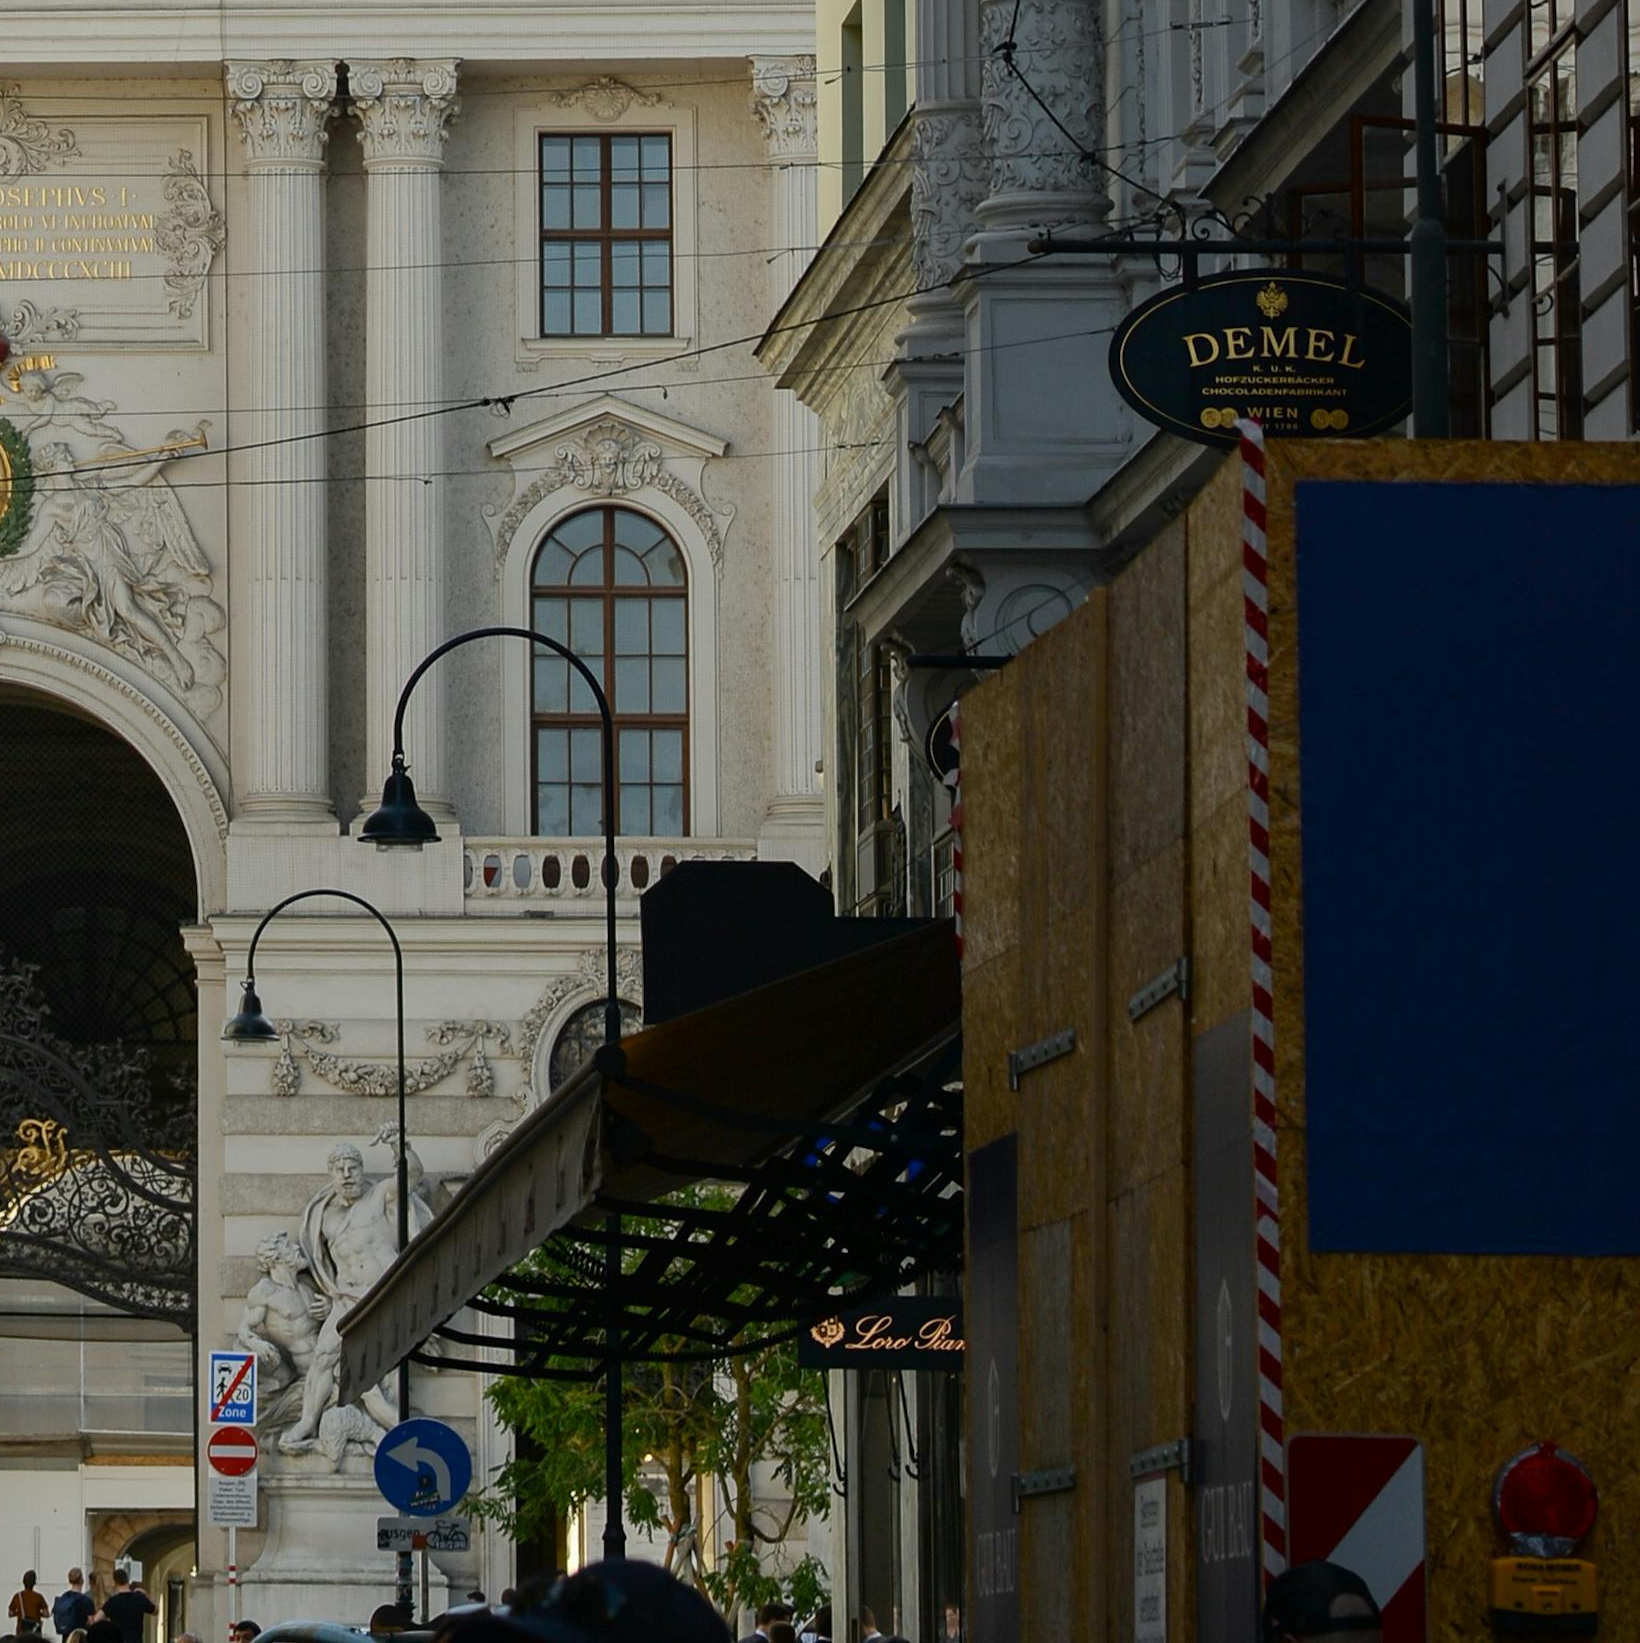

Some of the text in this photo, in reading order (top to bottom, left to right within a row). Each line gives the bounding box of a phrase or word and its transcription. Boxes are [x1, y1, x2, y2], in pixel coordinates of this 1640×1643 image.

[1182, 325, 1367, 370] DEMEL
[1201, 387, 1348, 396] CHOCOLADENFABRIKANT
[1246, 406, 1298, 419] WIEN
[844, 1314, 913, 1351] Loro
[235, 1389, 249, 1401] 20
[218, 1406, 247, 1418] Zone
